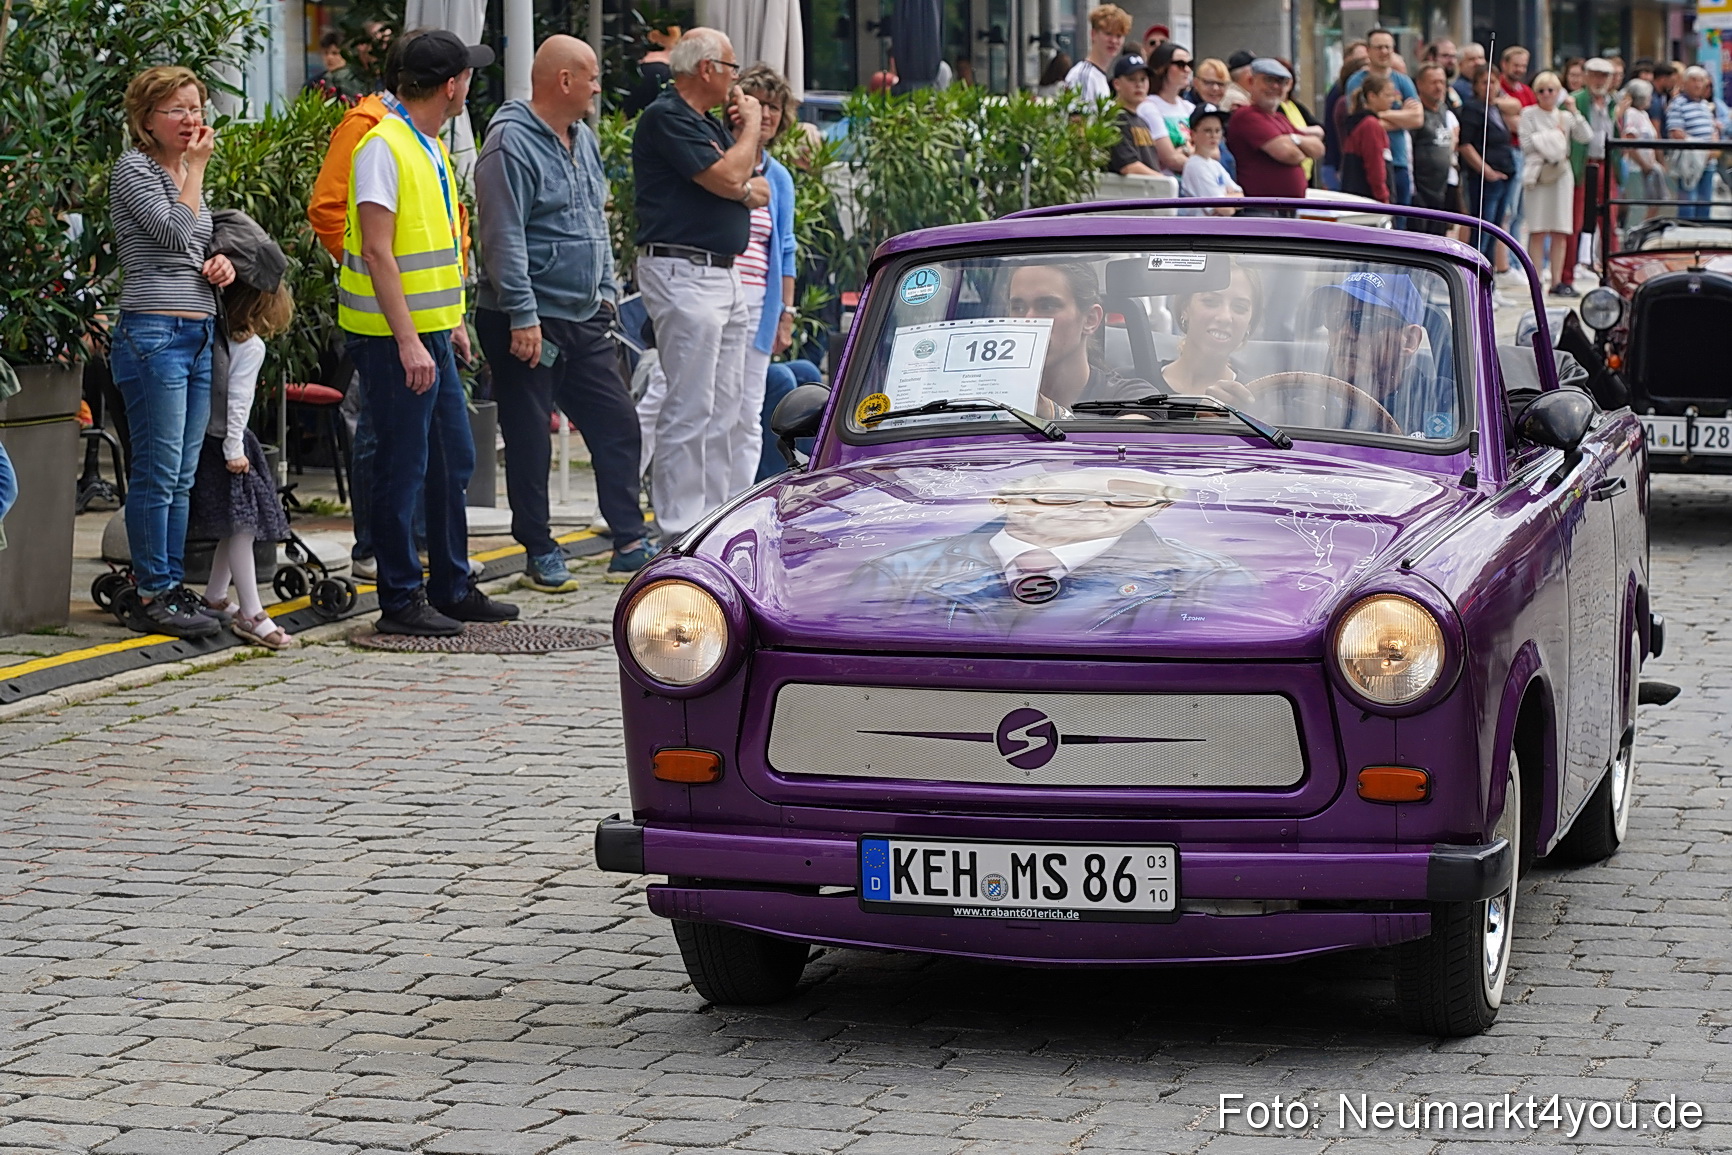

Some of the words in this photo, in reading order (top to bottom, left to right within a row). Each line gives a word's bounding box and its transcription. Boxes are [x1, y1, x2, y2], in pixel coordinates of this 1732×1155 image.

[965, 339, 1017, 363] 182
[1146, 855, 1168, 869] 03
[893, 847, 977, 898] KEH
[1010, 852, 1069, 901] MS
[1083, 853, 1138, 903] 86
[870, 877, 881, 890] D
[1148, 888, 1169, 902] 10
[953, 905, 1080, 920] www.trabant601erich.de
